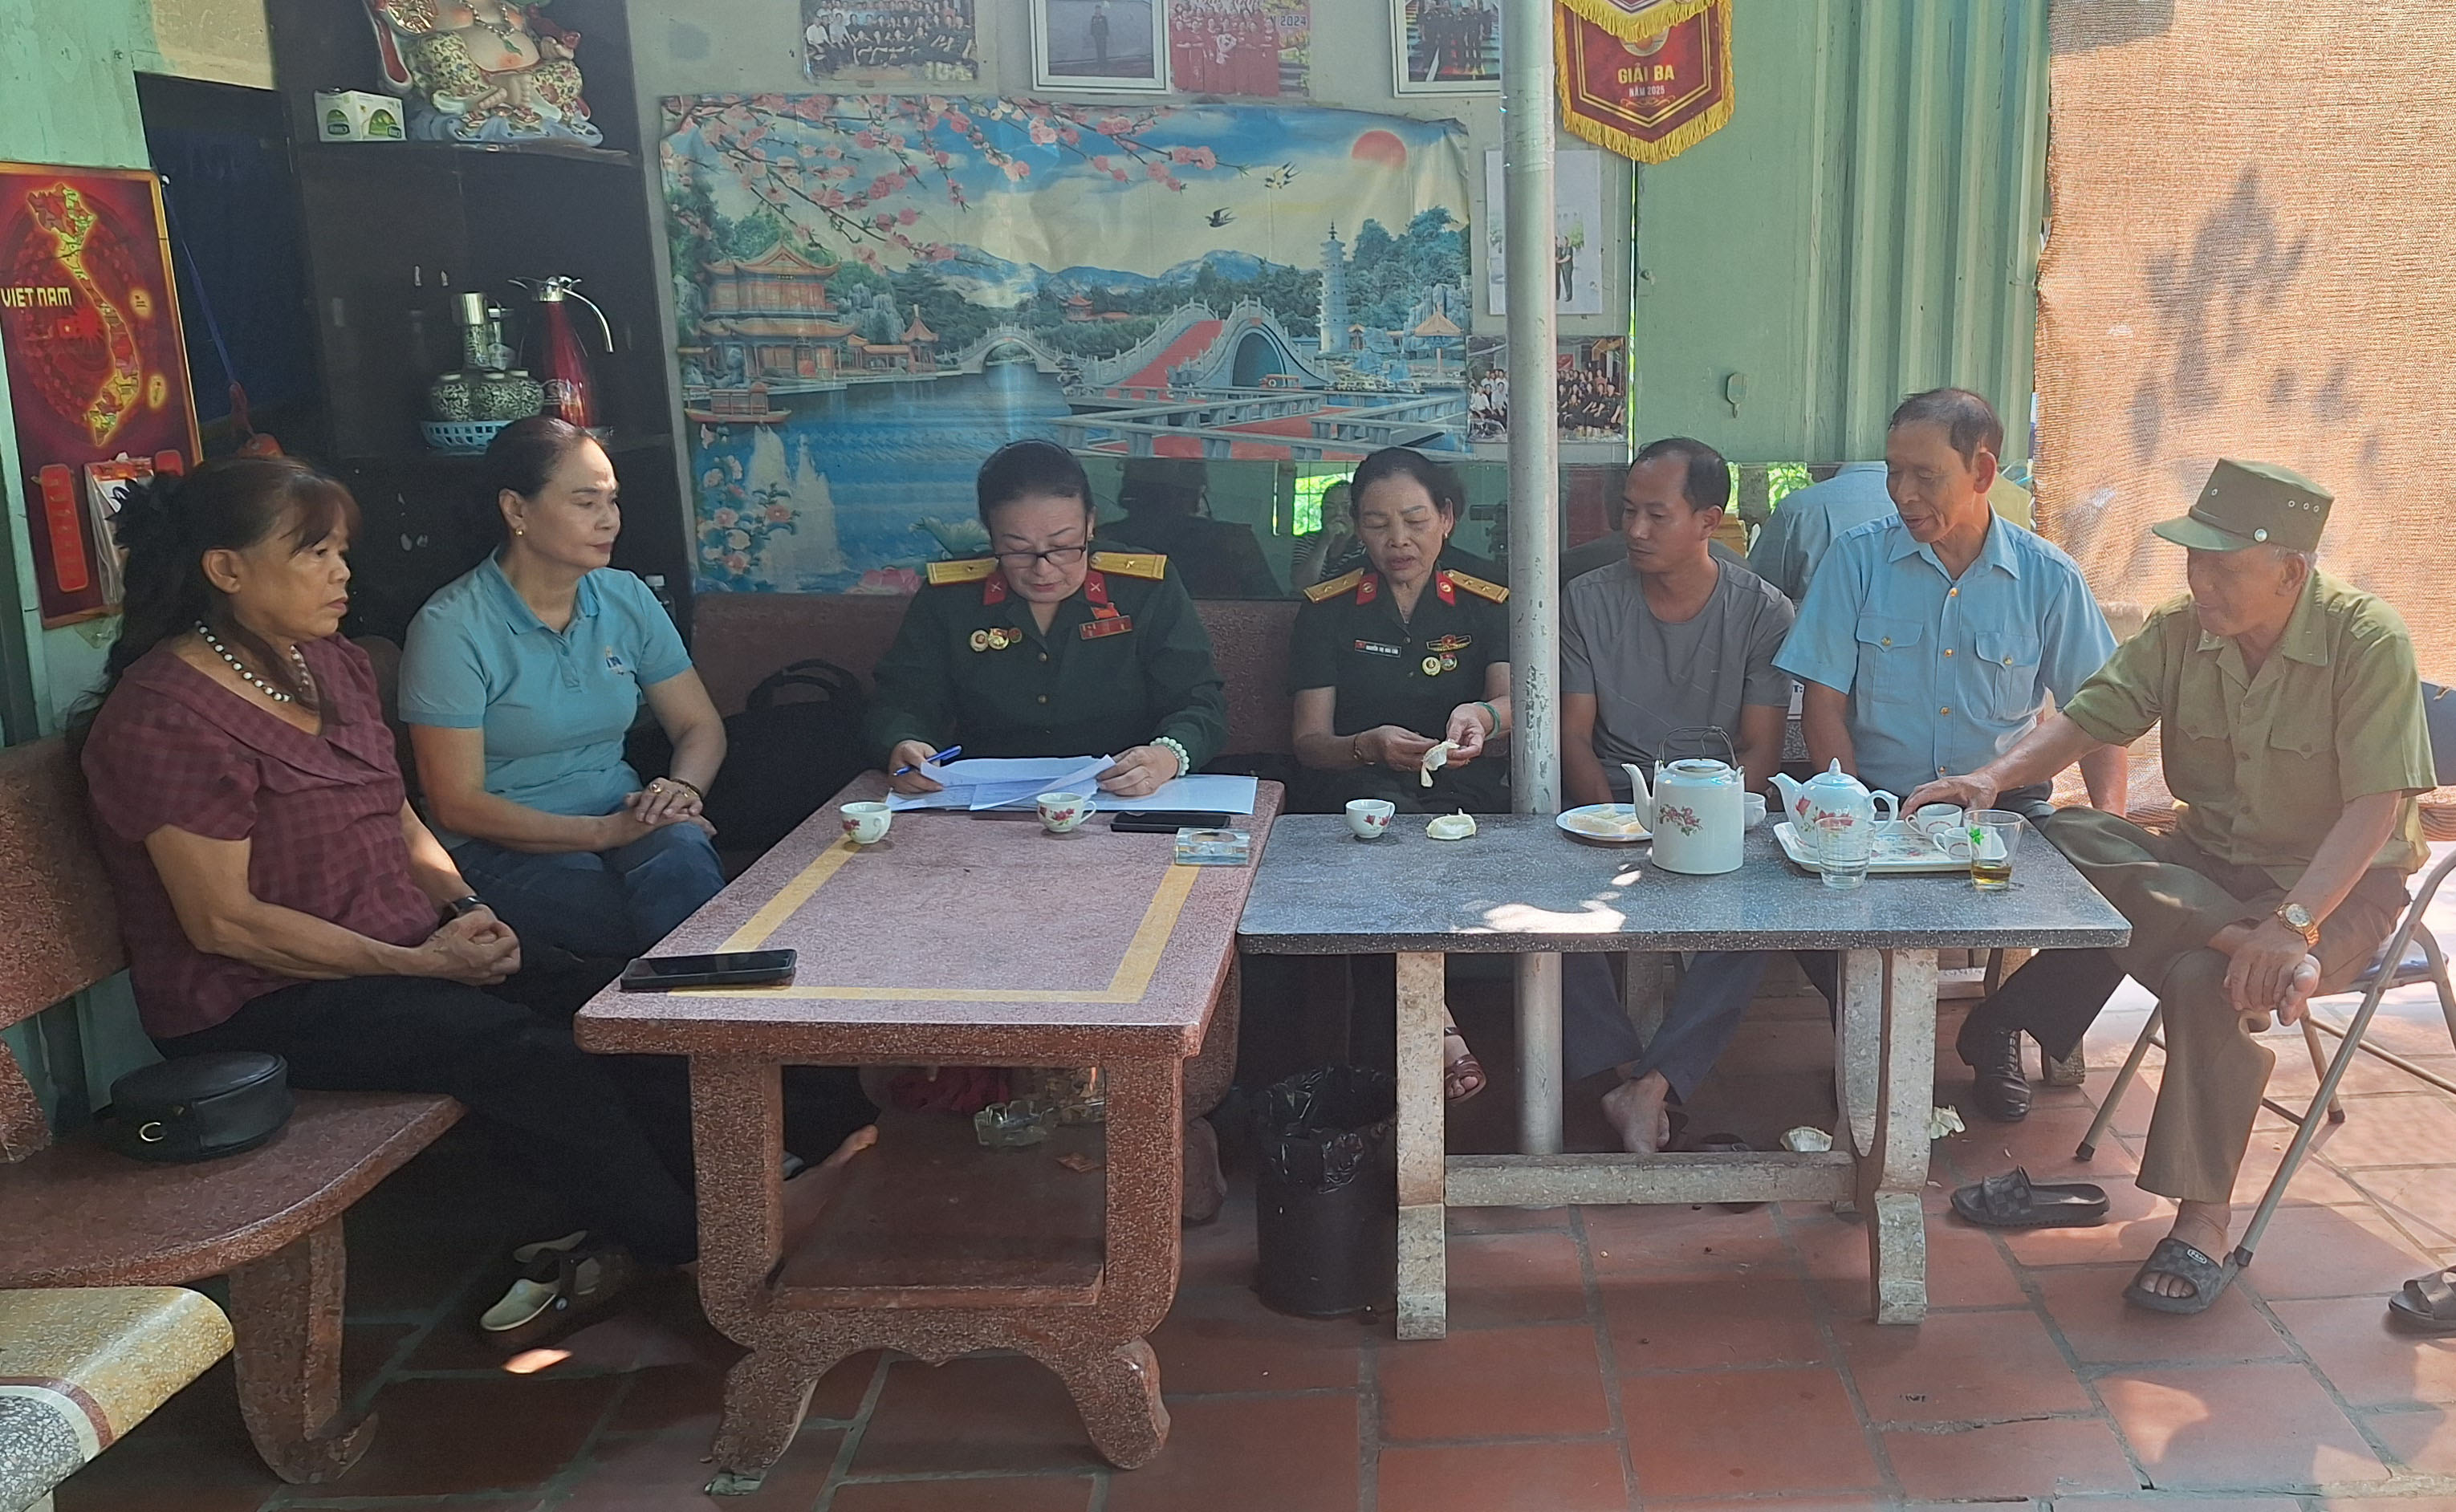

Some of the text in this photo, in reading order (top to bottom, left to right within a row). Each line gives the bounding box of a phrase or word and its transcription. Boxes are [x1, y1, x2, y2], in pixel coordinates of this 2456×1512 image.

[1279, 15, 1307, 26] 2024
[1617, 62, 1675, 84] GIẢI BA
[0, 287, 73, 307] VIET NAM
